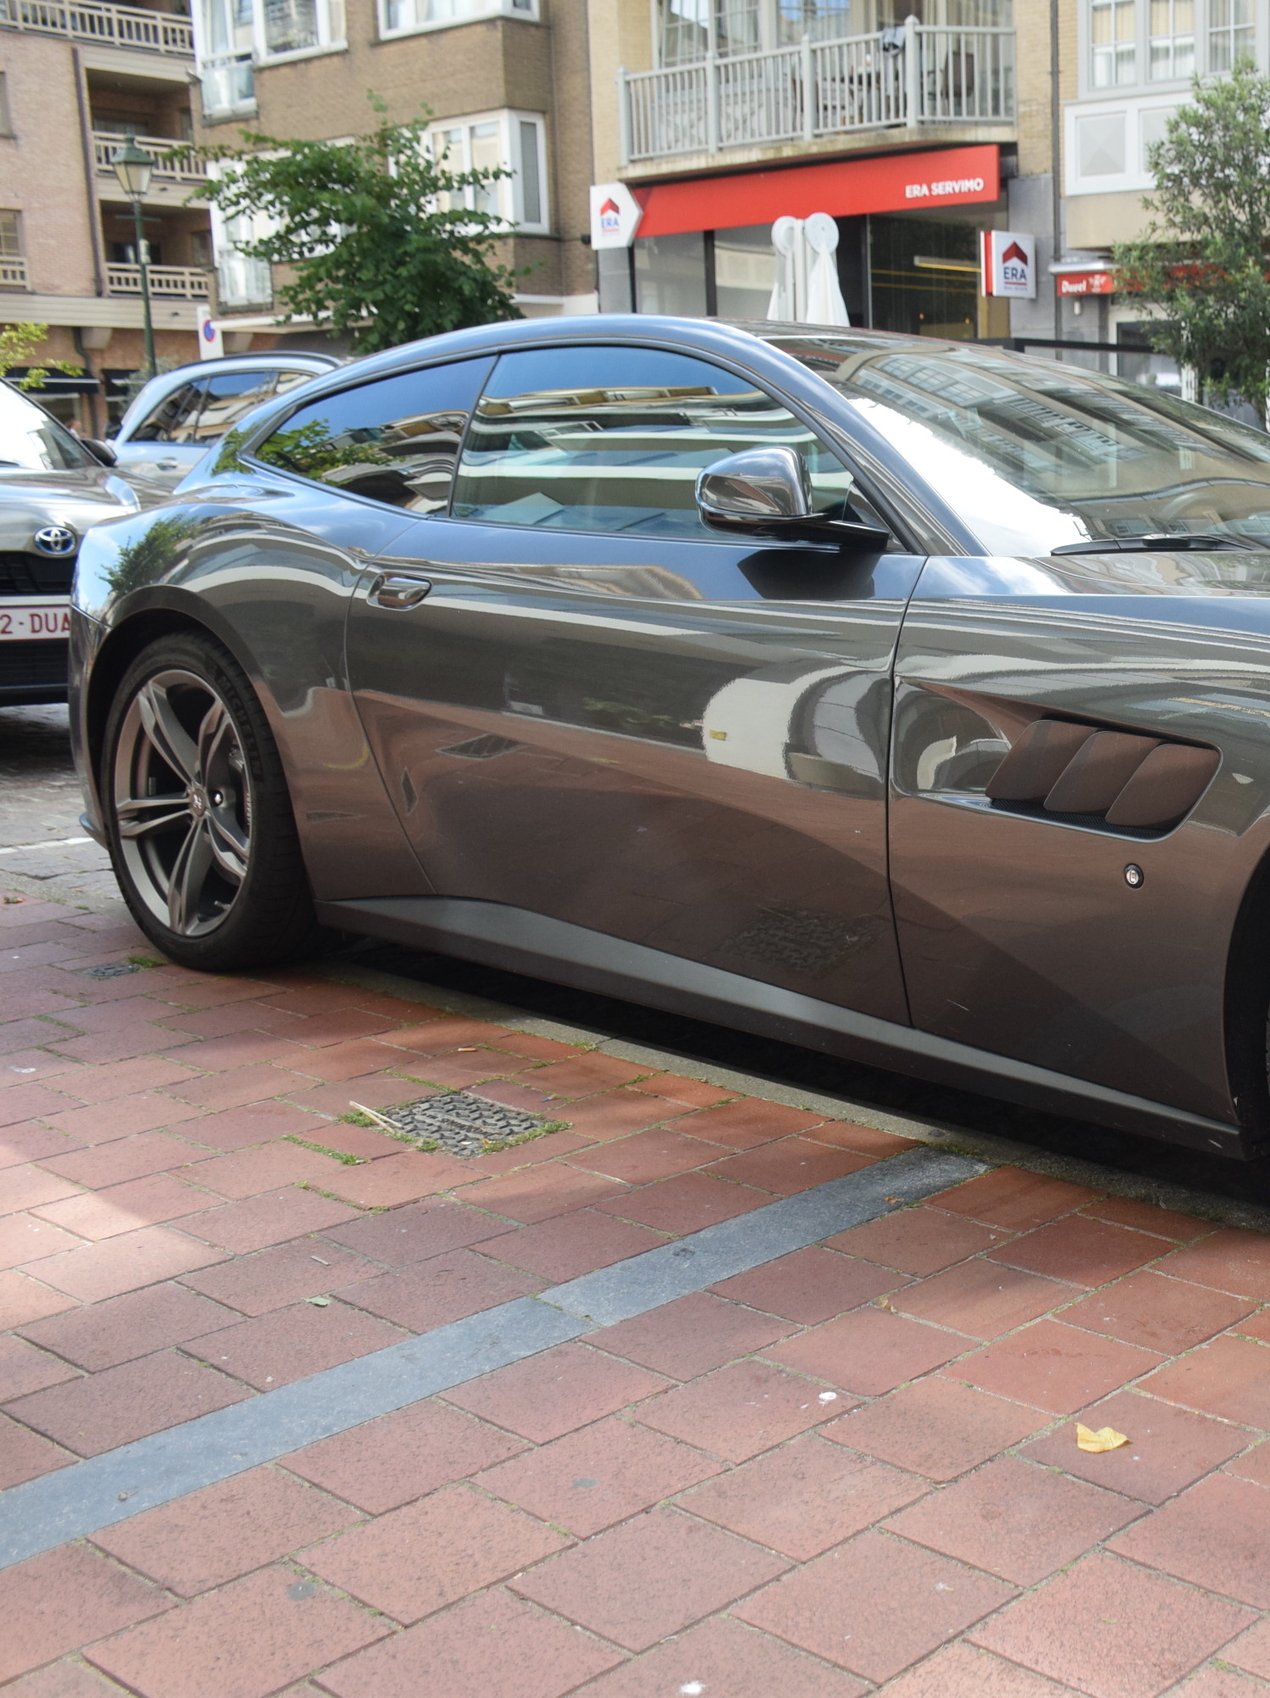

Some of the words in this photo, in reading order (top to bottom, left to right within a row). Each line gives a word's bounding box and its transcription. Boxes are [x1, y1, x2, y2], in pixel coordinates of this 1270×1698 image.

[905, 183, 930, 199] ERA
[931, 178, 984, 196] SERVIMO
[601, 217, 619, 229] ERA
[1003, 266, 1027, 280] ERA
